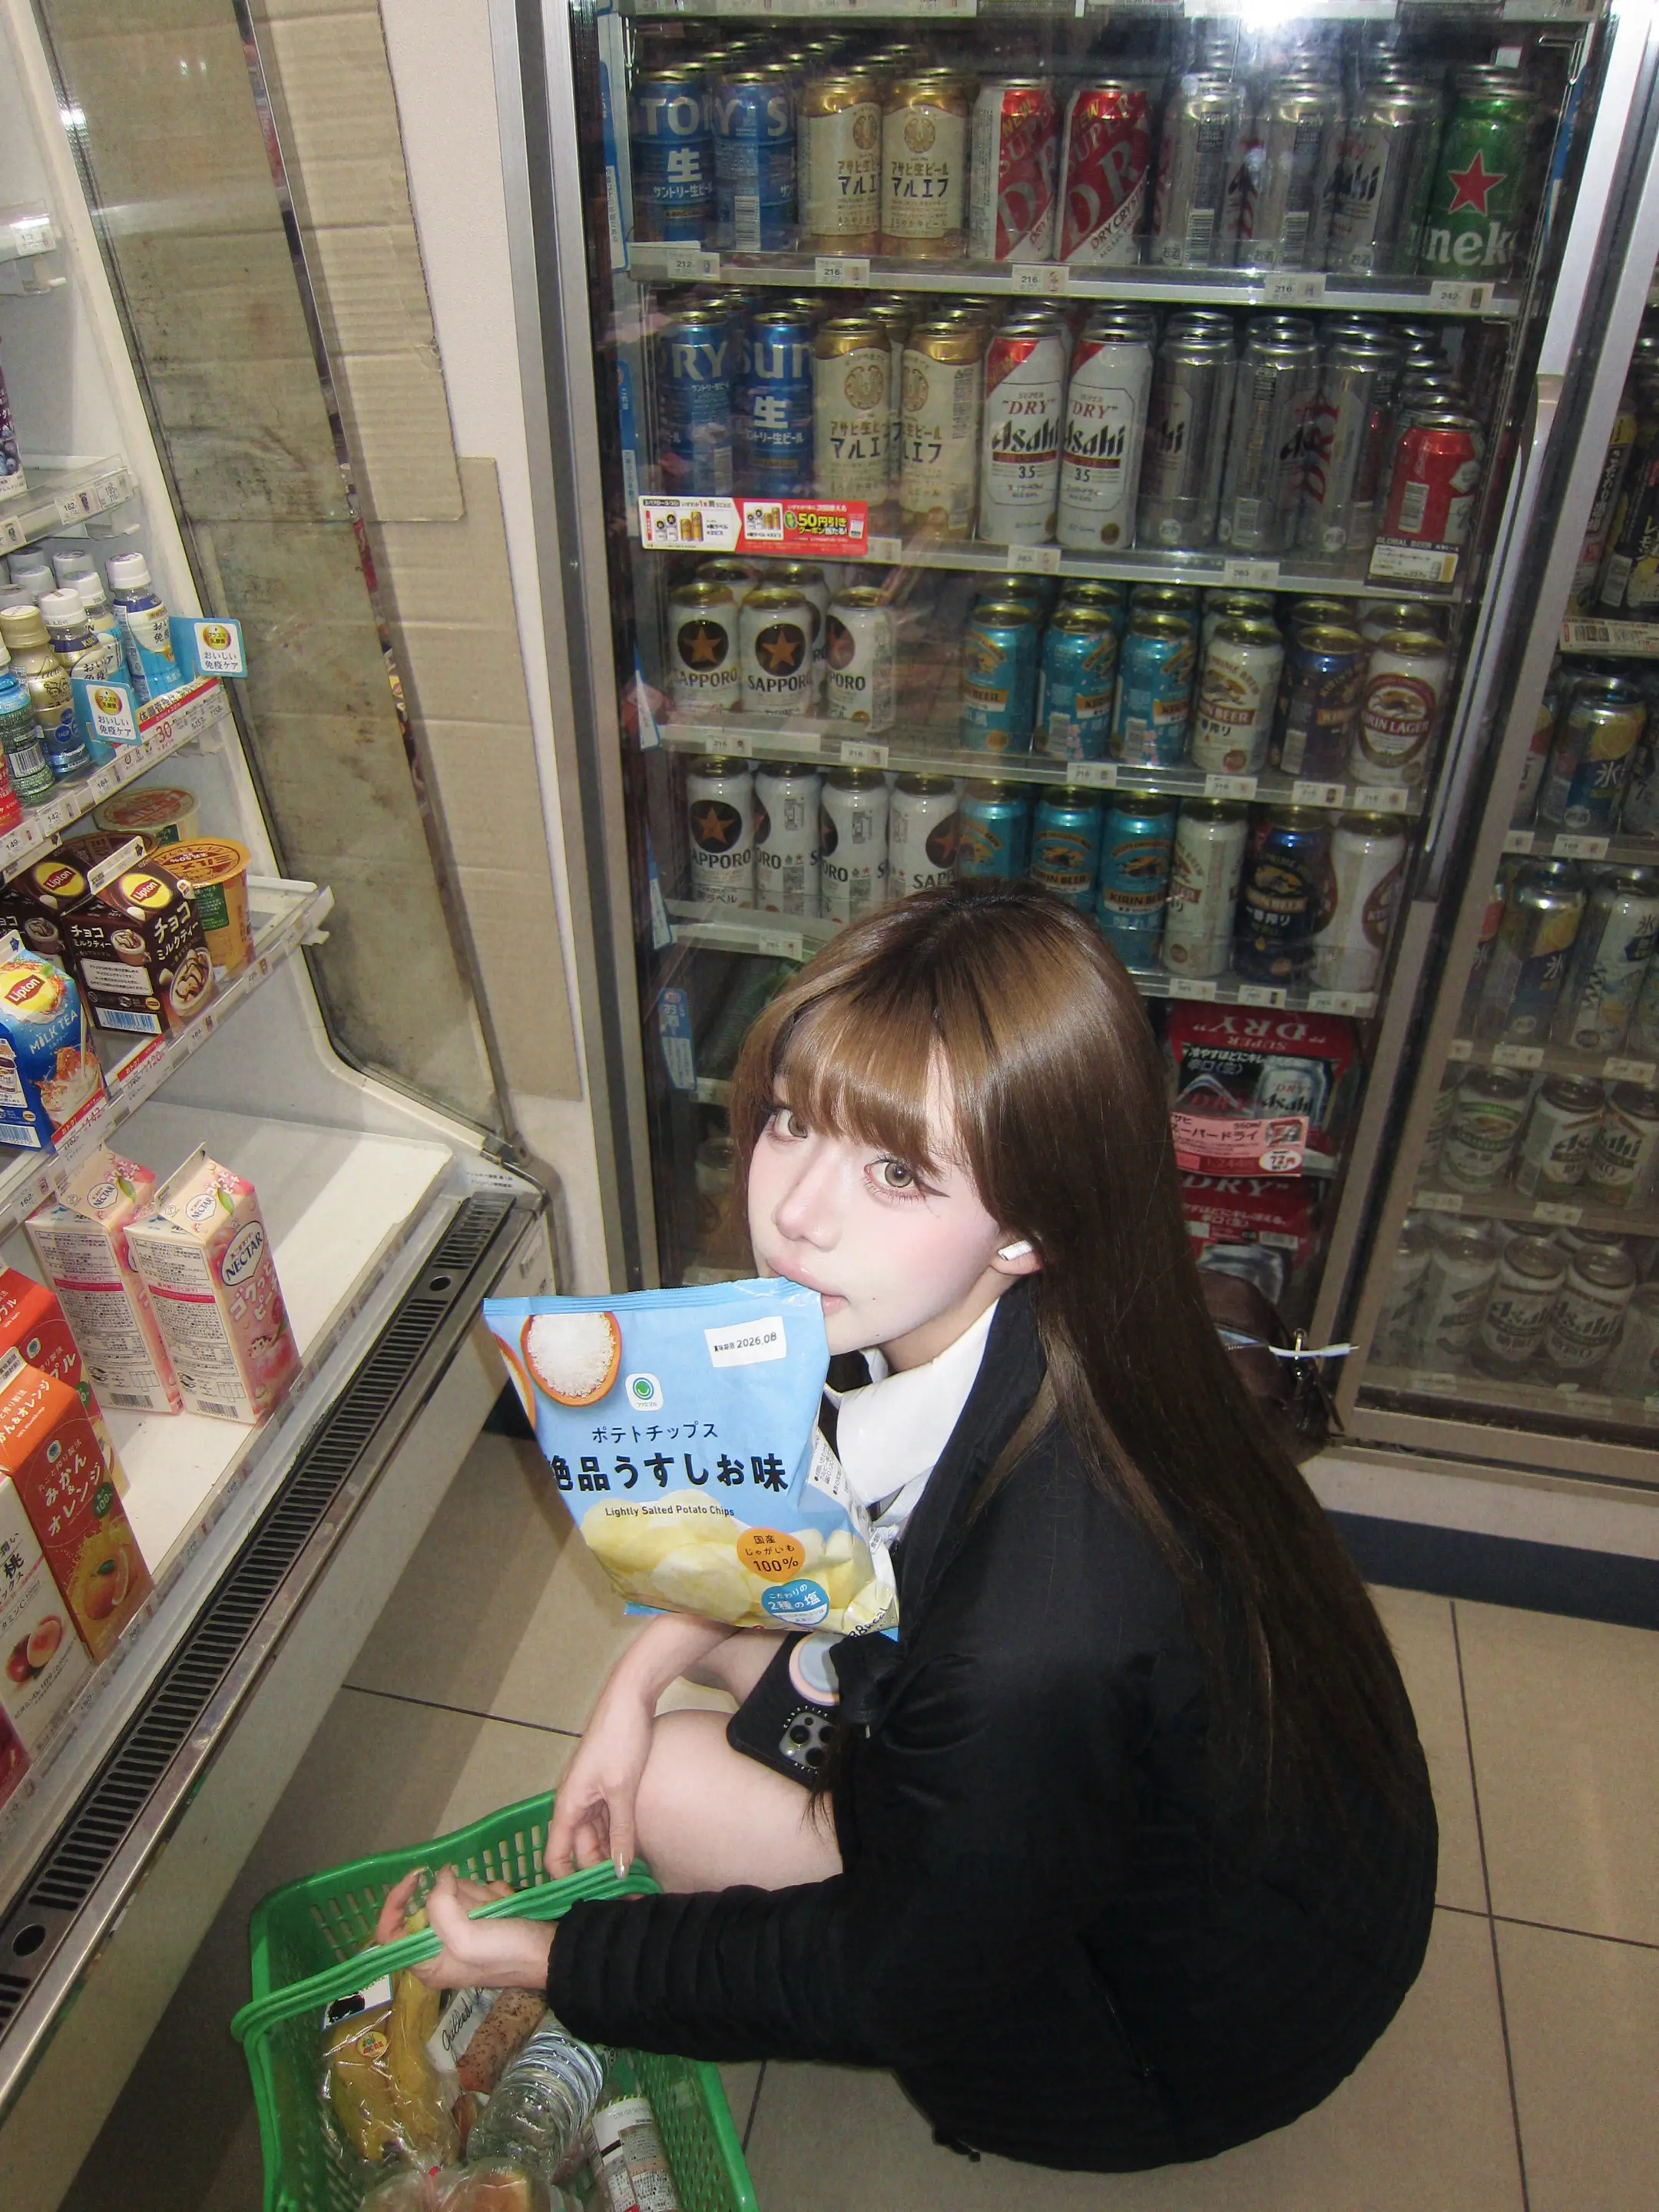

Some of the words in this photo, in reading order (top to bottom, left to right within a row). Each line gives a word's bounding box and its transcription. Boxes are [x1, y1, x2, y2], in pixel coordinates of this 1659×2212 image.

[667, 148, 703, 184] 生
[891, 161, 949, 177] アサヒ生ビール
[891, 176, 949, 198] マルエフ
[1417, 223, 1513, 265] nek
[753, 396, 789, 429] 生
[992, 417, 1061, 452] Asahi
[798, 513, 847, 528] 50円引き
[204, 651, 237, 661] おいしい
[204, 661, 239, 671] 免疫ケア
[747, 674, 813, 692] SAPPORO
[98, 715, 130, 726] おいしい
[99, 724, 131, 736] 免疫ケア
[47, 811, 59, 823] 142
[5, 839, 19, 851] 149
[46, 868, 72, 889] Lipton
[133, 879, 158, 902] Lipton
[1110, 892, 1144, 906] KIRIN
[71, 924, 104, 939] チョコ
[154, 901, 192, 944] チョコ
[74, 940, 112, 949] ミルクティー
[157, 922, 199, 961] ミルクティー
[8, 977, 40, 1003] Lipton
[29, 1025, 58, 1055] MILK
[58, 1009, 78, 1030] TEA
[93, 1185, 115, 1207] NECTAR
[191, 1197, 214, 1220] NECTAR
[225, 1231, 263, 1282] NECTAR
[737, 1331, 777, 1349] 2026.08
[591, 1420, 718, 1444] ポテトチップス
[45, 1453, 87, 1508] みかん
[48, 1462, 102, 1538] オレンジ
[605, 1505, 640, 1518] Lightly
[642, 1505, 674, 1515] Salted
[676, 1505, 707, 1515] Potato
[710, 1505, 735, 1517] Chips
[753, 1534, 777, 1545] 国産
[745, 1544, 795, 1556] じゃがいも
[3, 1552, 26, 1581] 桃
[753, 1556, 799, 1572] 100%
[768, 1591, 822, 1611] 2種の塩
[769, 1583, 808, 1599] こだわりの
